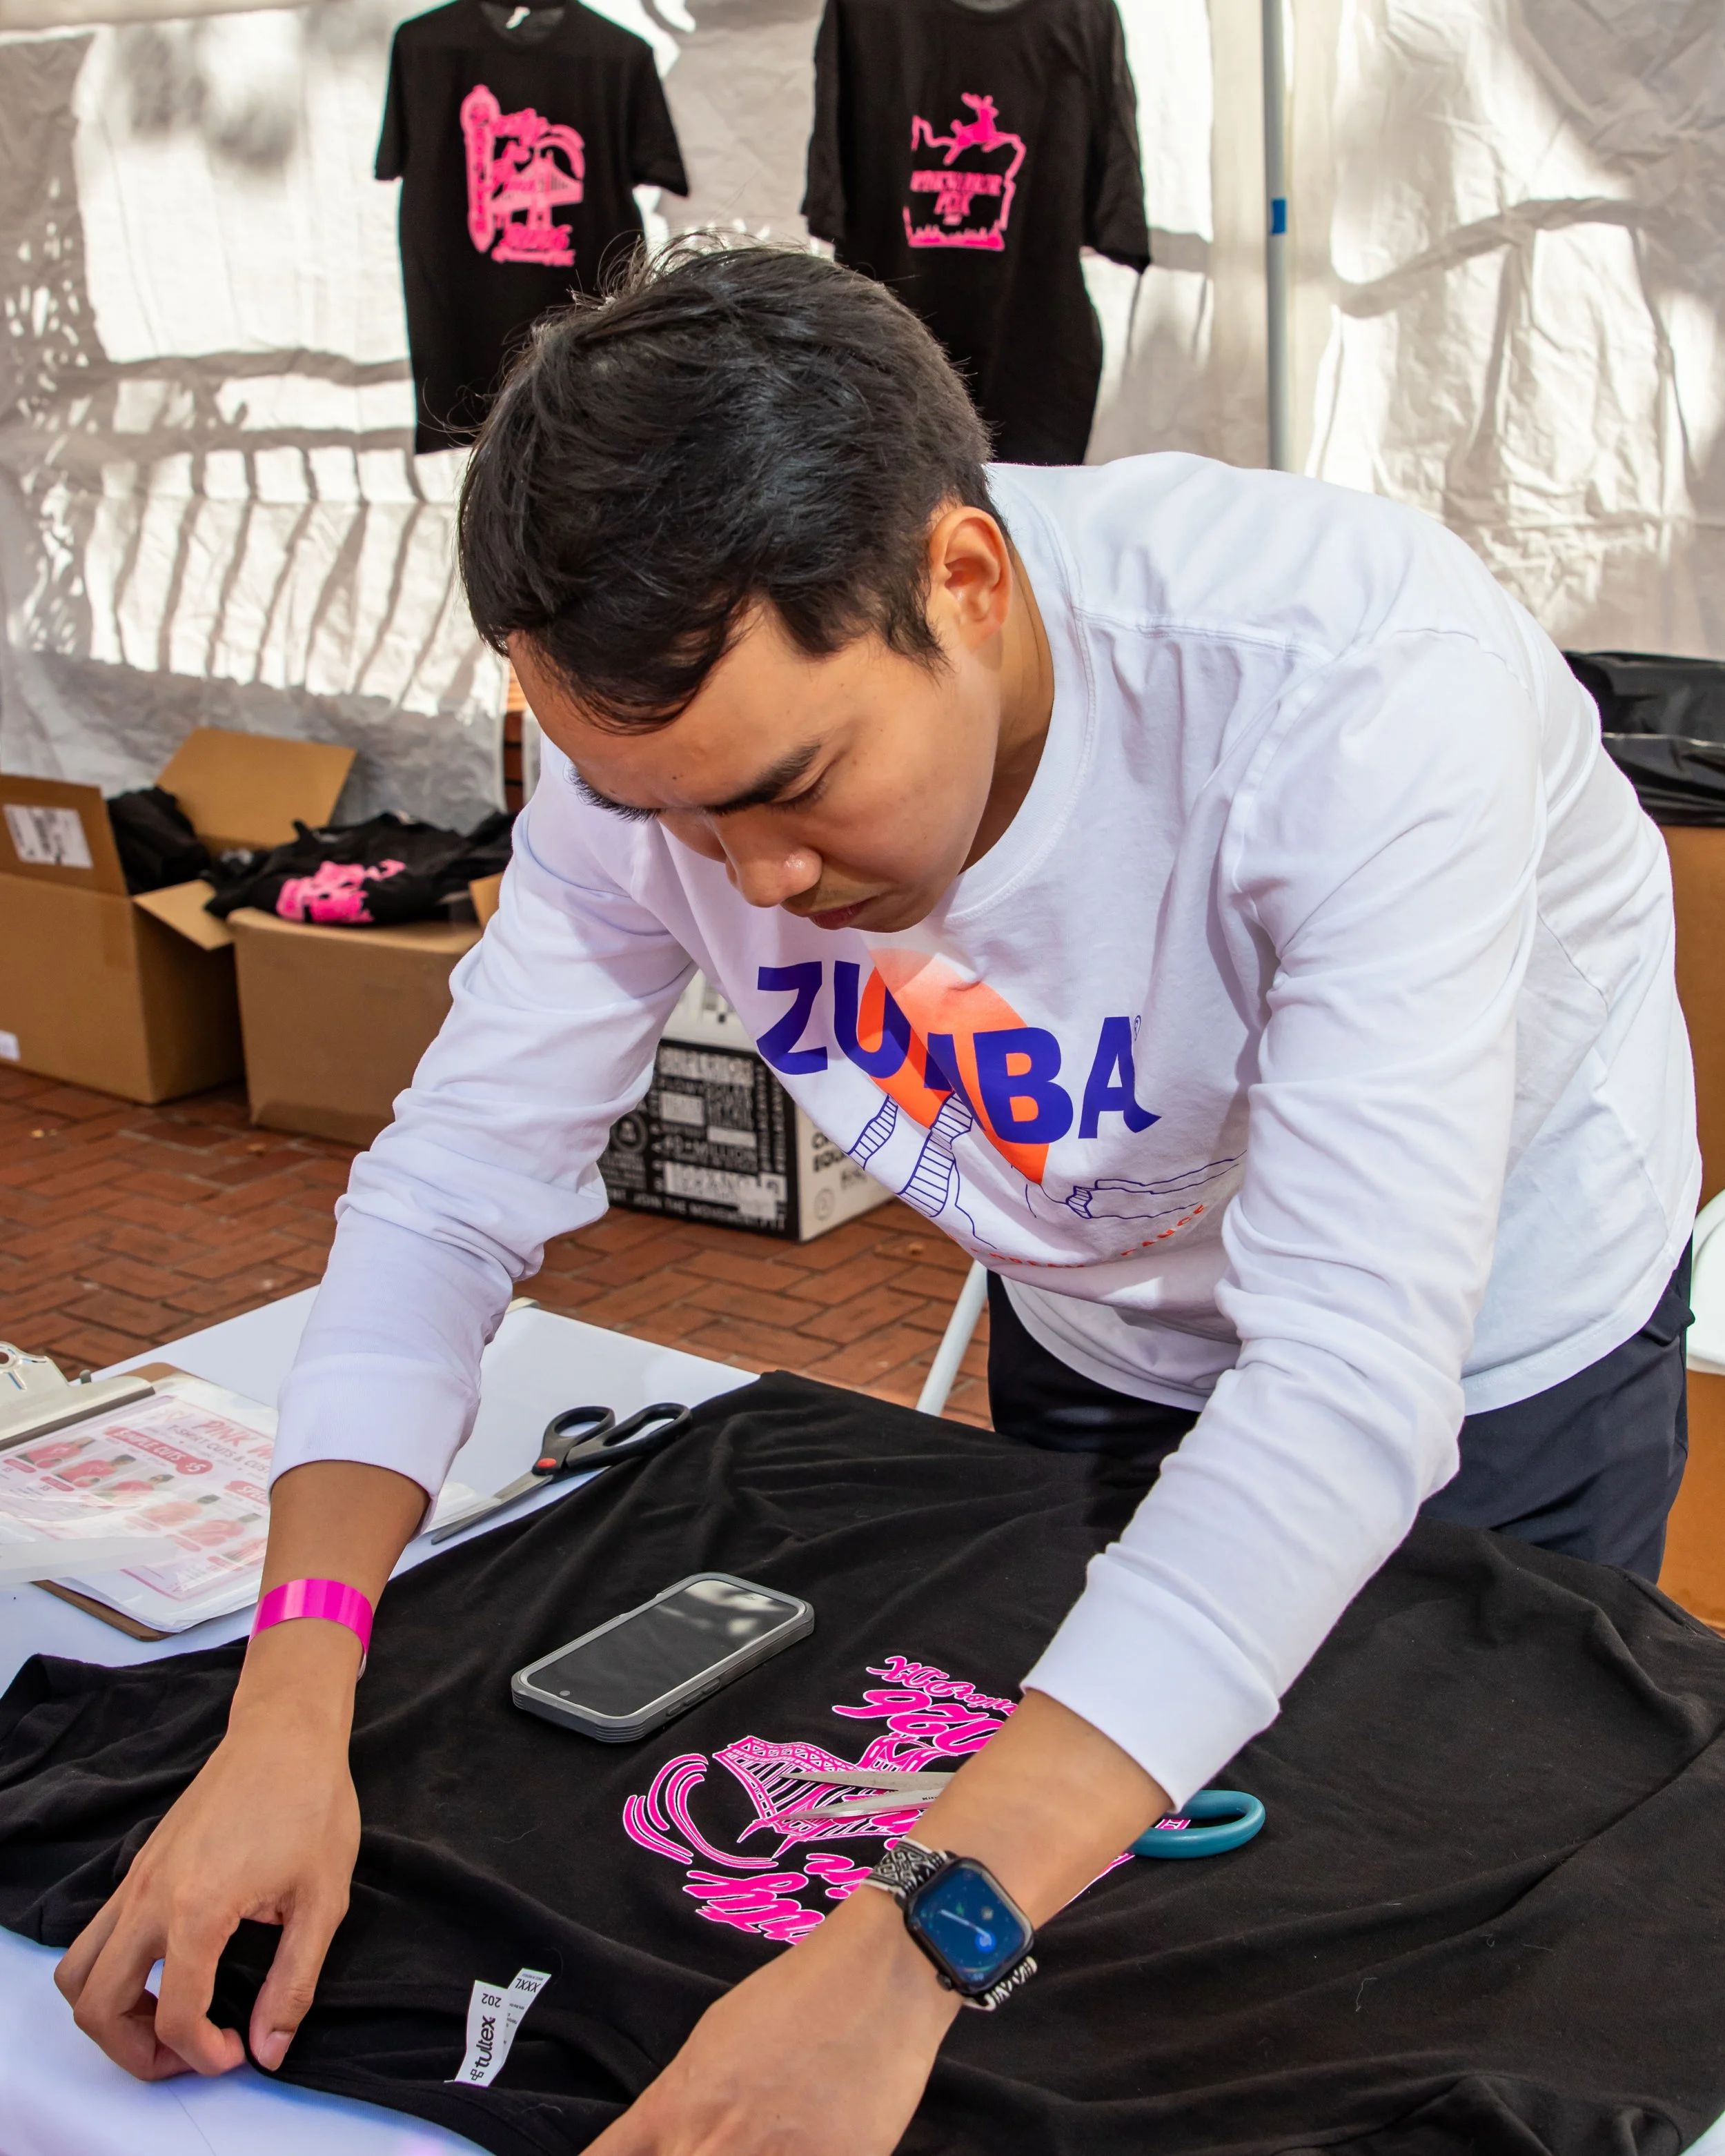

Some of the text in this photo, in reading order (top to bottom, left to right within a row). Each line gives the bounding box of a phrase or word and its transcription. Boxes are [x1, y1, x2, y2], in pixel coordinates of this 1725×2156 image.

[190, 1420, 258, 1447] PINK
[153, 1446, 186, 1461] CUTS
[186, 1462, 206, 1472] $5
[207, 1443, 237, 1458] CUTS
[832, 1690, 1005, 1755] 026
[515, 1978, 541, 1993] XXXL
[481, 1992, 502, 2008] 202
[475, 2015, 496, 2068] tultex
